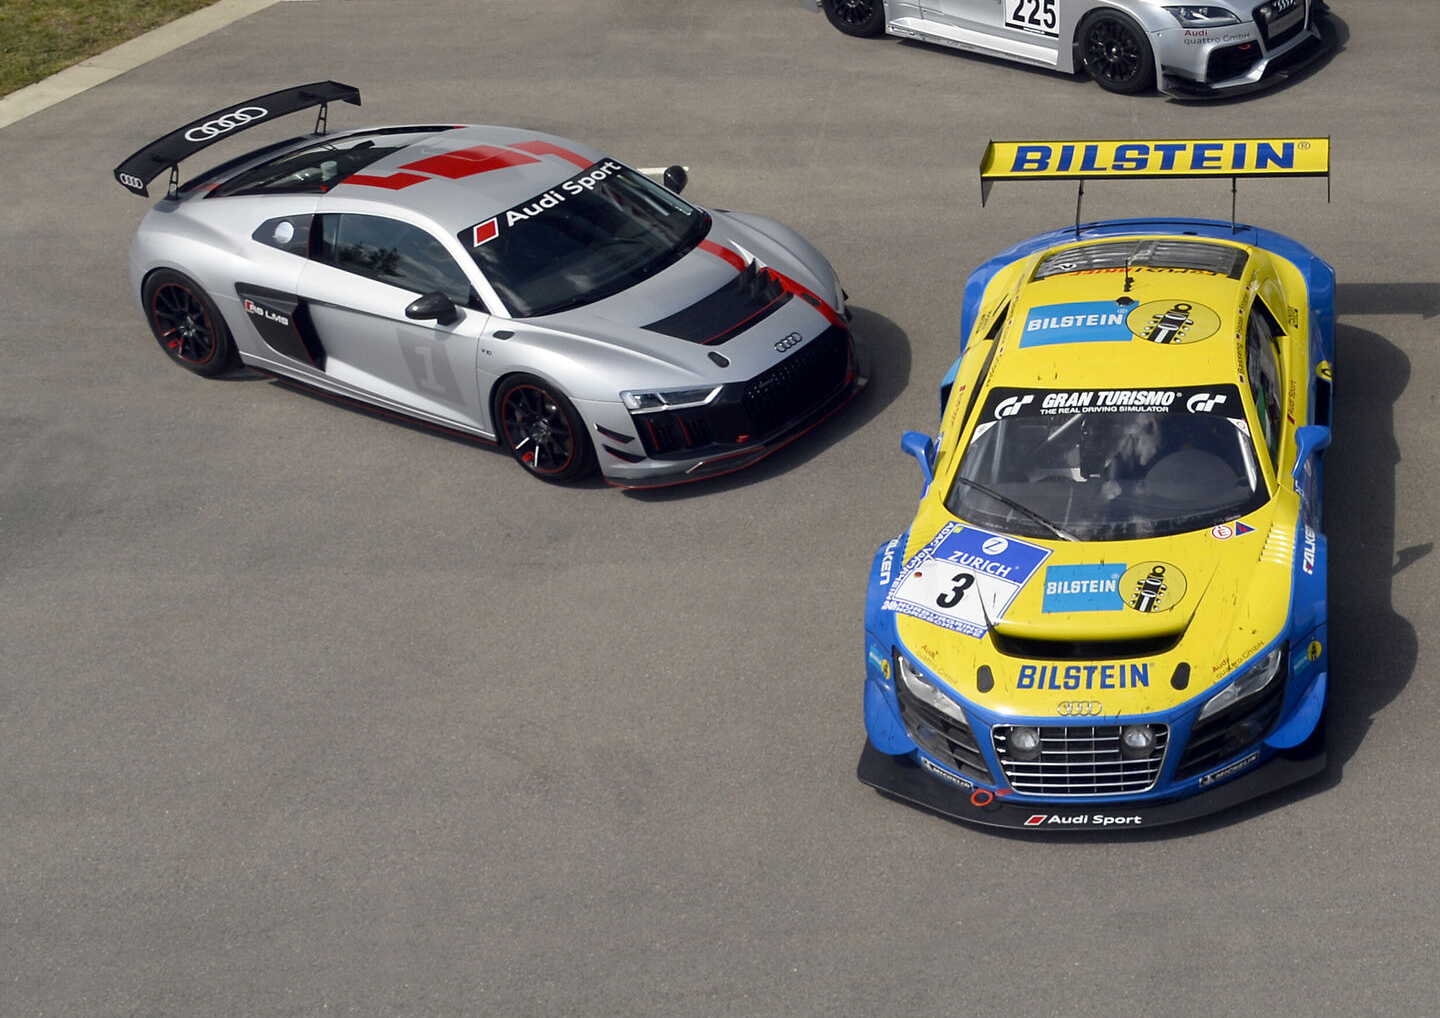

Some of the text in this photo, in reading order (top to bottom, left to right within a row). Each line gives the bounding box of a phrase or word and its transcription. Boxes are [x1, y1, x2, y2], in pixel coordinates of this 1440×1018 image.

[1184, 29, 1208, 37] Audi
[1184, 32, 1250, 45] quattro GmbH
[1010, 142, 1295, 172] BILSTEIN
[506, 161, 622, 228] Audi Sport
[265, 310, 289, 326] LMS
[1027, 313, 1124, 332] BILSTEIN
[1042, 390, 1176, 409] GRAN TURISMO
[948, 550, 1012, 578] ZURICH
[936, 572, 976, 609] 3
[1046, 579, 1117, 595] BILSTEIN
[1016, 663, 1150, 691] BILSTEIN
[1047, 813, 1142, 828] Audi Sport
